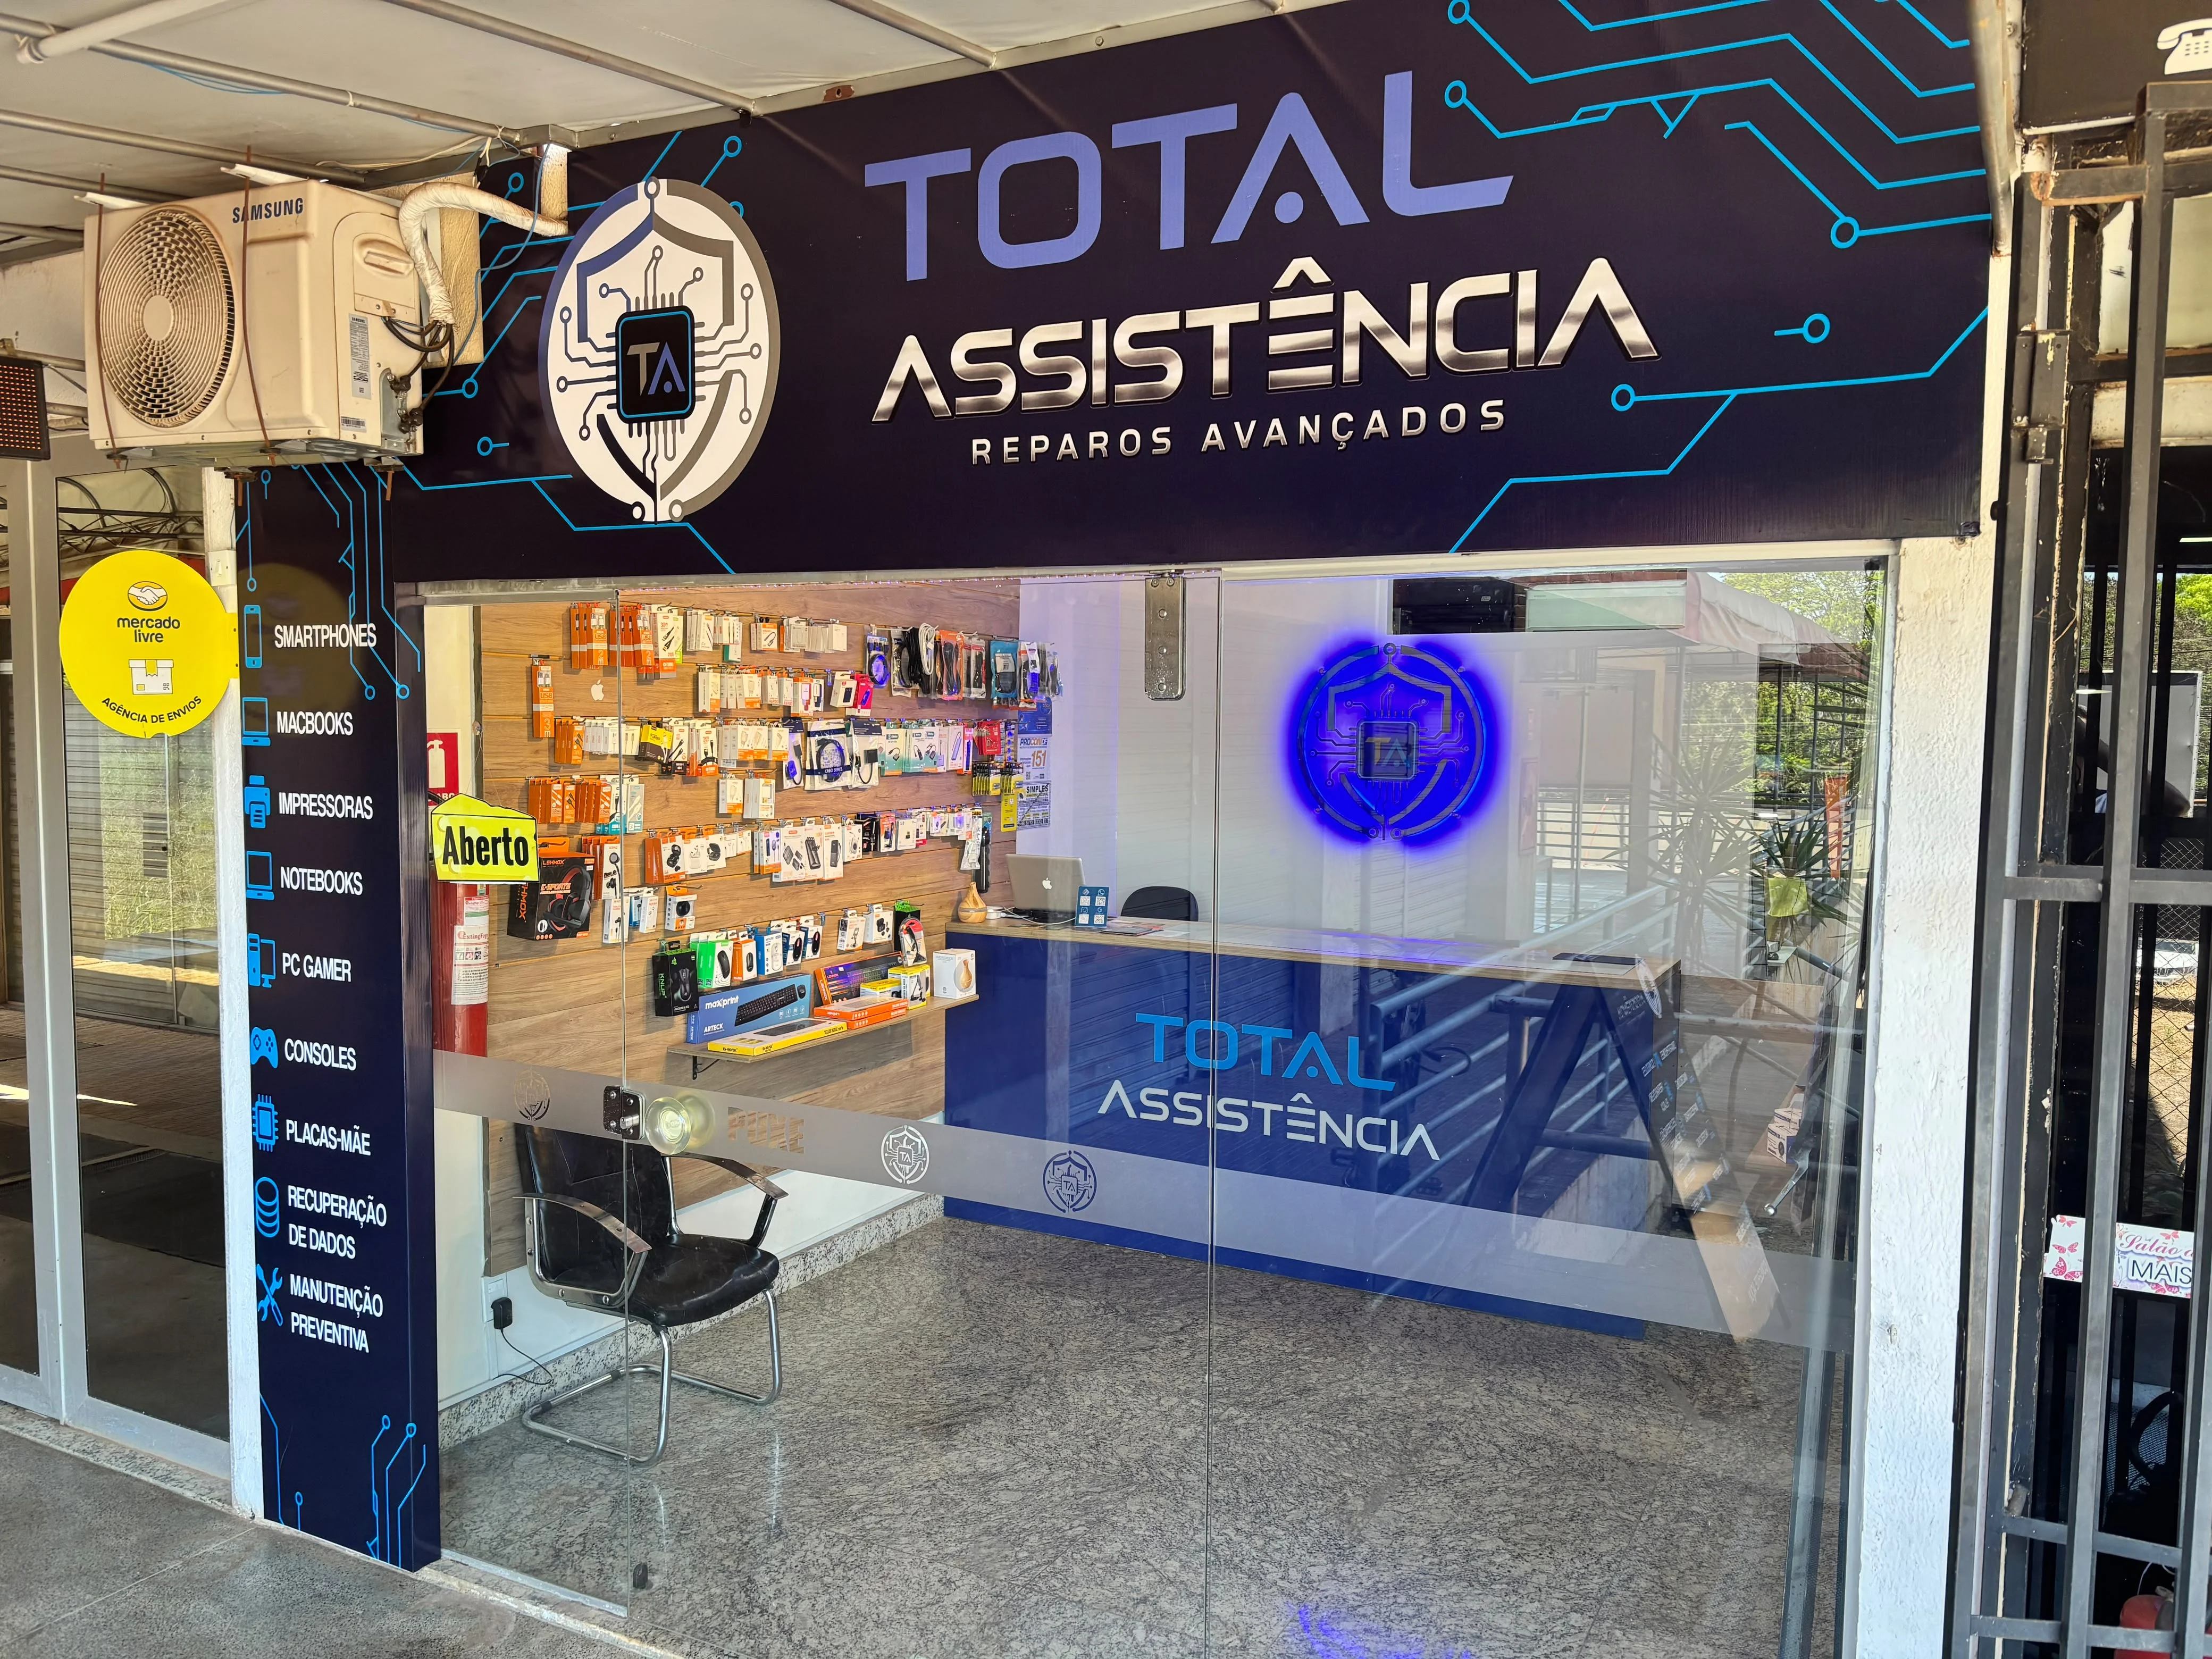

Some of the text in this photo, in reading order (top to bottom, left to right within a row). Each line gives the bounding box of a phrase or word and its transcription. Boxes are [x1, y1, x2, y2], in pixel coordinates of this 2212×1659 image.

[865, 71, 1514, 282] TOTAL
[871, 256, 1660, 423] ASSISTÊNCIA
[626, 341, 686, 396] TA
[970, 399, 1506, 466] REPAROS AVANÇADOS
[116, 616, 181, 630] mercado
[134, 629, 164, 643] livre
[274, 623, 377, 648] SMARTPHONES
[102, 696, 202, 724] AGÊNCIA DE ENVIOS
[276, 710, 354, 736] MACBOOKS
[1031, 750, 1047, 767] 151
[1365, 737, 1411, 768] TA
[1026, 785, 1049, 793] SIMPLES
[279, 792, 373, 820] IMPRESSORAS
[442, 825, 529, 867] Aberto
[280, 867, 364, 896] NOTEBOOKS
[282, 953, 352, 983] PC GAMER
[705, 995, 739, 1010] maxprint
[703, 1023, 724, 1033] ARTECK
[284, 1038, 357, 1071] CONSOLES
[1135, 1012, 1396, 1092] TOTAL
[1097, 1079, 1440, 1161] ASSISTÊNCIA
[286, 1119, 371, 1157] PLACAS-MÃE
[899, 1151, 911, 1163] TA
[1063, 1180, 1076, 1192] TA
[288, 1185, 387, 1229] RECUPERAÇÃO
[289, 1224, 356, 1260] DE DADOS
[2119, 1234, 2183, 1255] Salão
[2131, 1260, 2192, 1285] MAIS
[290, 1273, 383, 1319] MANUTENÇÃO
[291, 1312, 370, 1353] PREVENTIVA
